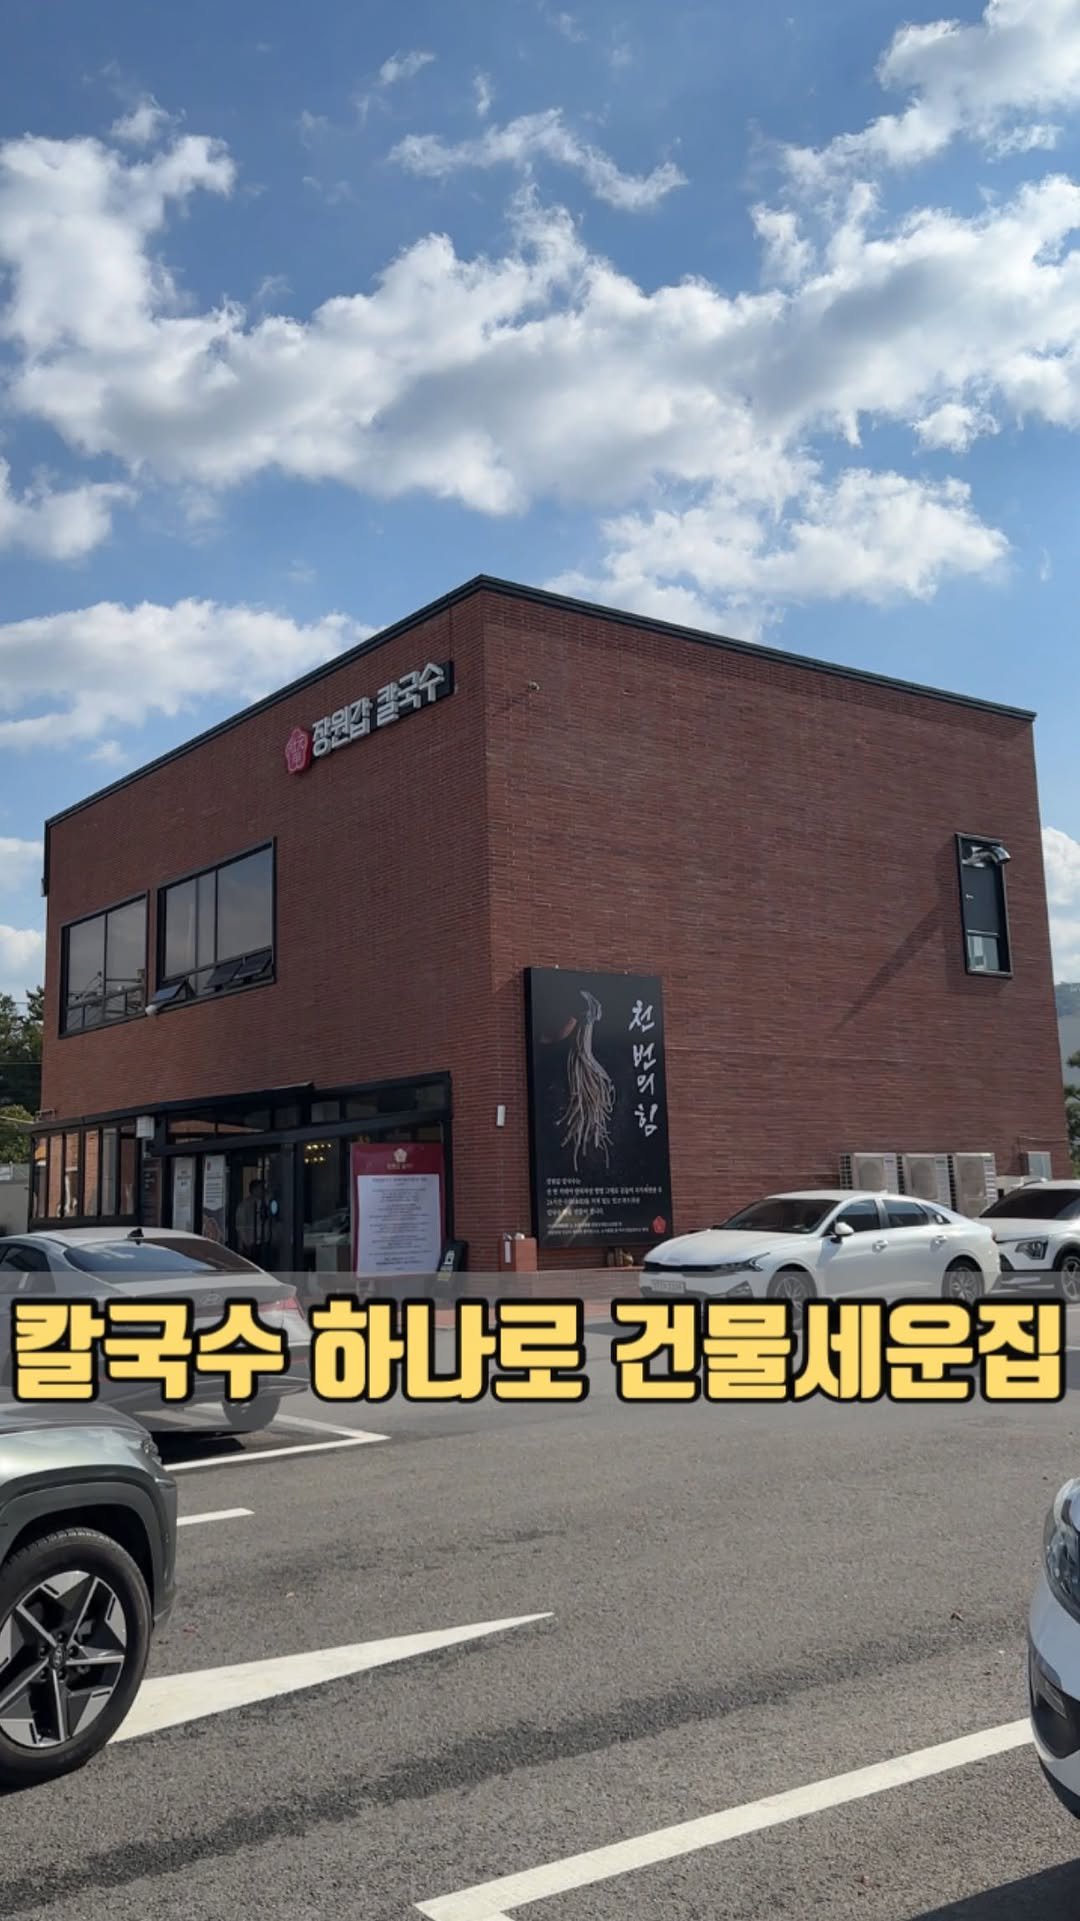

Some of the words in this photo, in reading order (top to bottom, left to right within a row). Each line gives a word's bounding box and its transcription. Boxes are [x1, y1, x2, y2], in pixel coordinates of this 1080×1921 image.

[312, 697, 373, 757] 장원갑
[377, 663, 445, 726] 칼국수
[629, 1000, 655, 1032] 천
[633, 1043, 656, 1096] 번의
[634, 1104, 658, 1137] 힘
